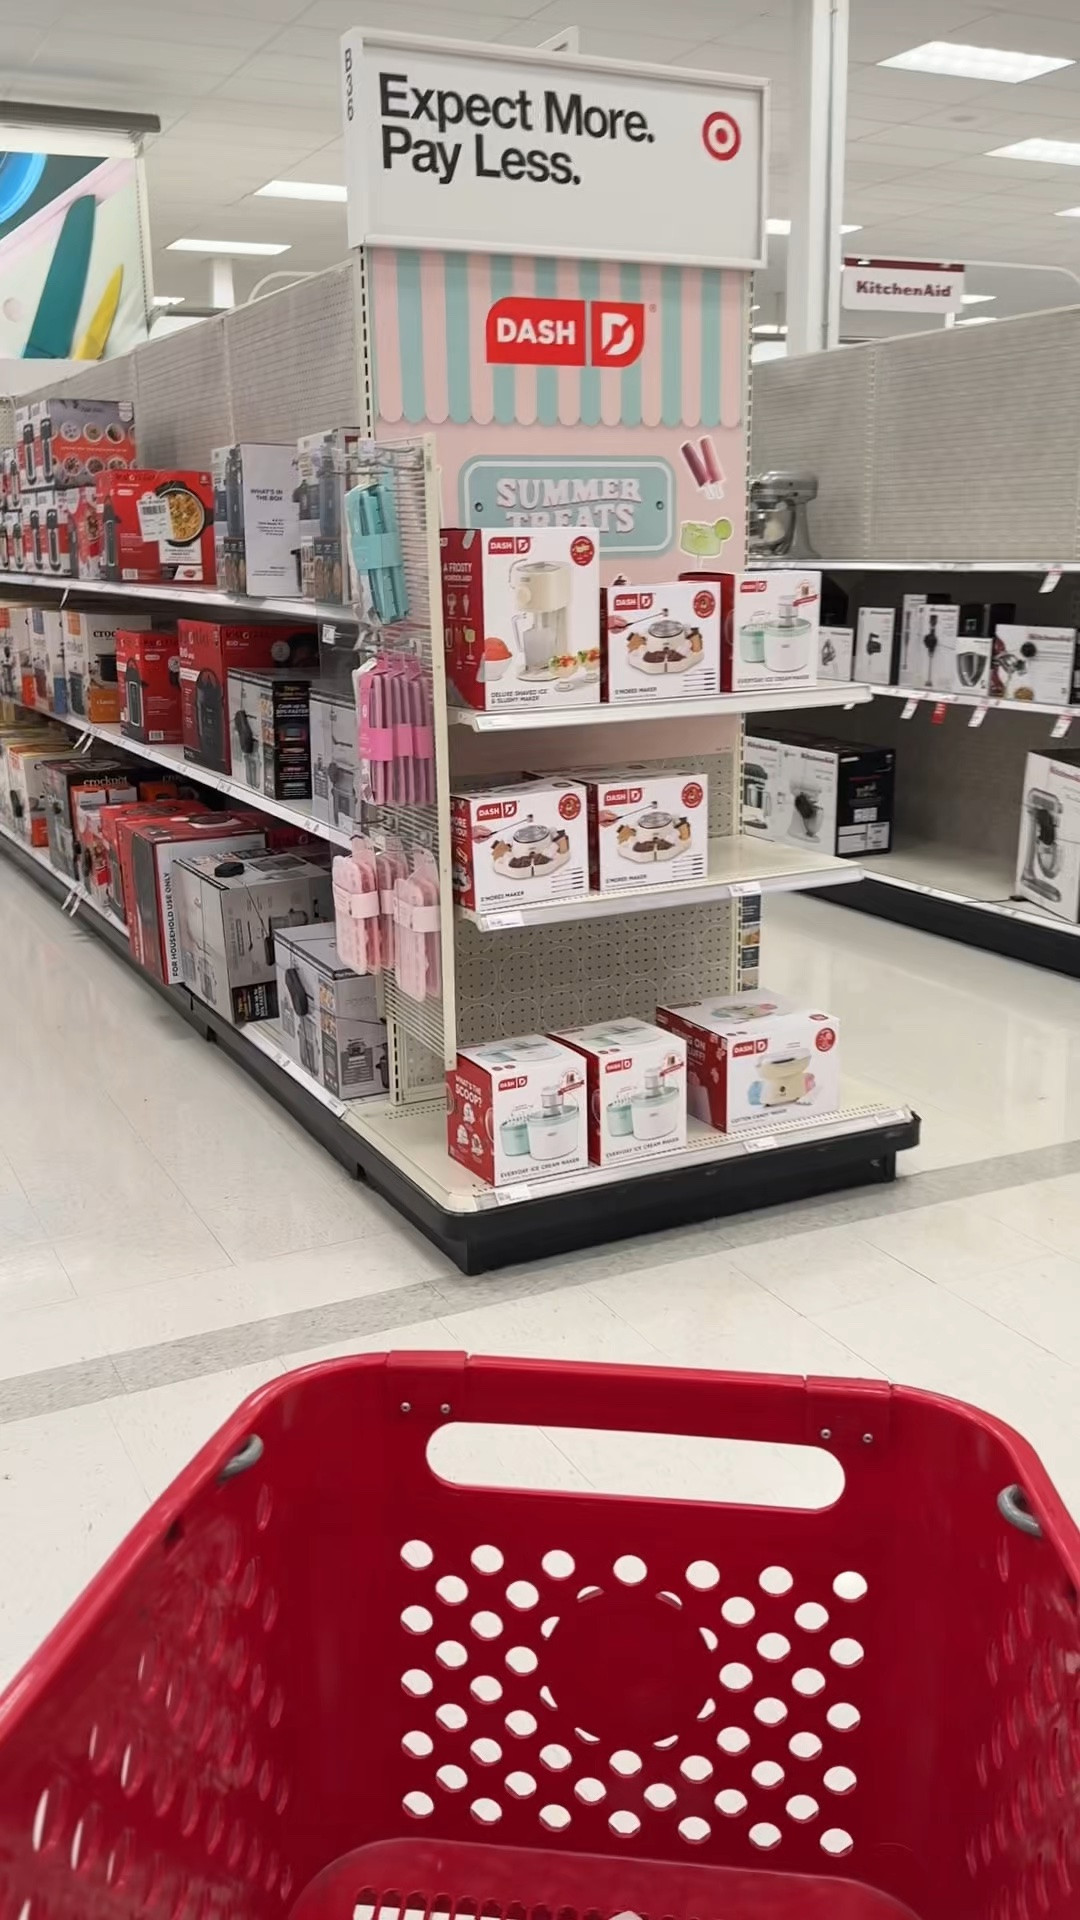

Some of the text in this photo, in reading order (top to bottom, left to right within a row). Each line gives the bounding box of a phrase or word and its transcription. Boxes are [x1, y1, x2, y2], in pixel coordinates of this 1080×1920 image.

[379, 73, 656, 143] Expect More.
[382, 125, 581, 185] Pay Less.
[856, 281, 952, 298] KitchenAid
[496, 317, 576, 345] DASH
[250, 488, 275, 496] WHAT'S
[496, 478, 642, 510] SUMMER
[506, 504, 636, 533] TREATS
[490, 542, 513, 550] DASH
[605, 794, 626, 802] DASH
[478, 808, 500, 816] DASH
[163, 872, 172, 893] ONLY
[166, 895, 175, 910] USE
[168, 911, 178, 961] HOUSEHOLD
[734, 1044, 753, 1053] DASH
[455, 1083, 482, 1108] SCOOP?
[500, 1157, 580, 1179] EVERYDAY ICE CREAM MAKER
